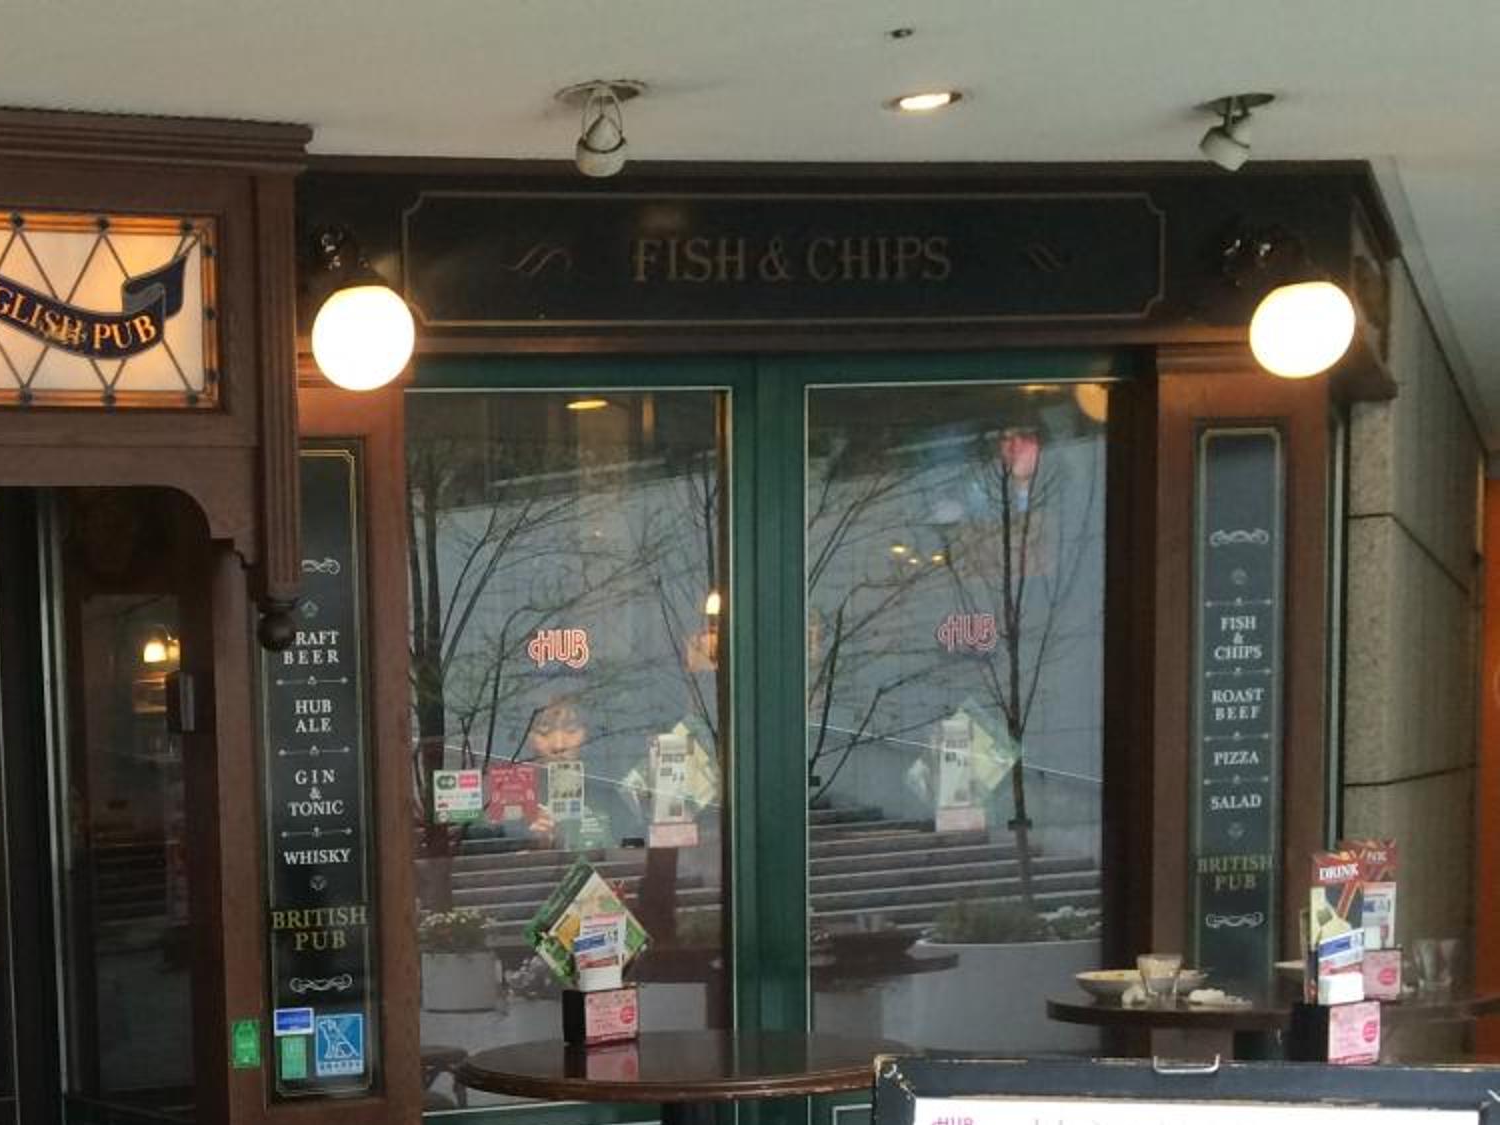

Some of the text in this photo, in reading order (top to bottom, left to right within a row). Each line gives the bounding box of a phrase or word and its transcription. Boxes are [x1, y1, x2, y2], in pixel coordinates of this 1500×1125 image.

[632, 235, 952, 283] FISH & CHIPS
[93, 312, 159, 351] PUB
[1221, 615, 1256, 631] FISH
[294, 630, 340, 646] RAFT
[1233, 632, 1244, 645] &
[283, 649, 340, 665] BEER
[528, 628, 589, 669] HUB
[1214, 644, 1262, 660] CHIPS
[1212, 687, 1265, 704] ROAST
[295, 699, 332, 714] HUB
[1215, 704, 1261, 721] BEEF
[295, 717, 332, 733] ALE
[1213, 751, 1260, 767] PIZZA
[295, 769, 336, 785] GIN
[309, 786, 323, 800] &
[1211, 793, 1262, 810] SALAD
[287, 800, 345, 817] TONIC
[283, 848, 352, 866] WHISKY
[1197, 854, 1273, 873] BRITISH
[1319, 863, 1359, 880] DRINK
[1215, 872, 1258, 892] PUB
[272, 905, 367, 929] BRITISH
[294, 929, 347, 951] PUB
